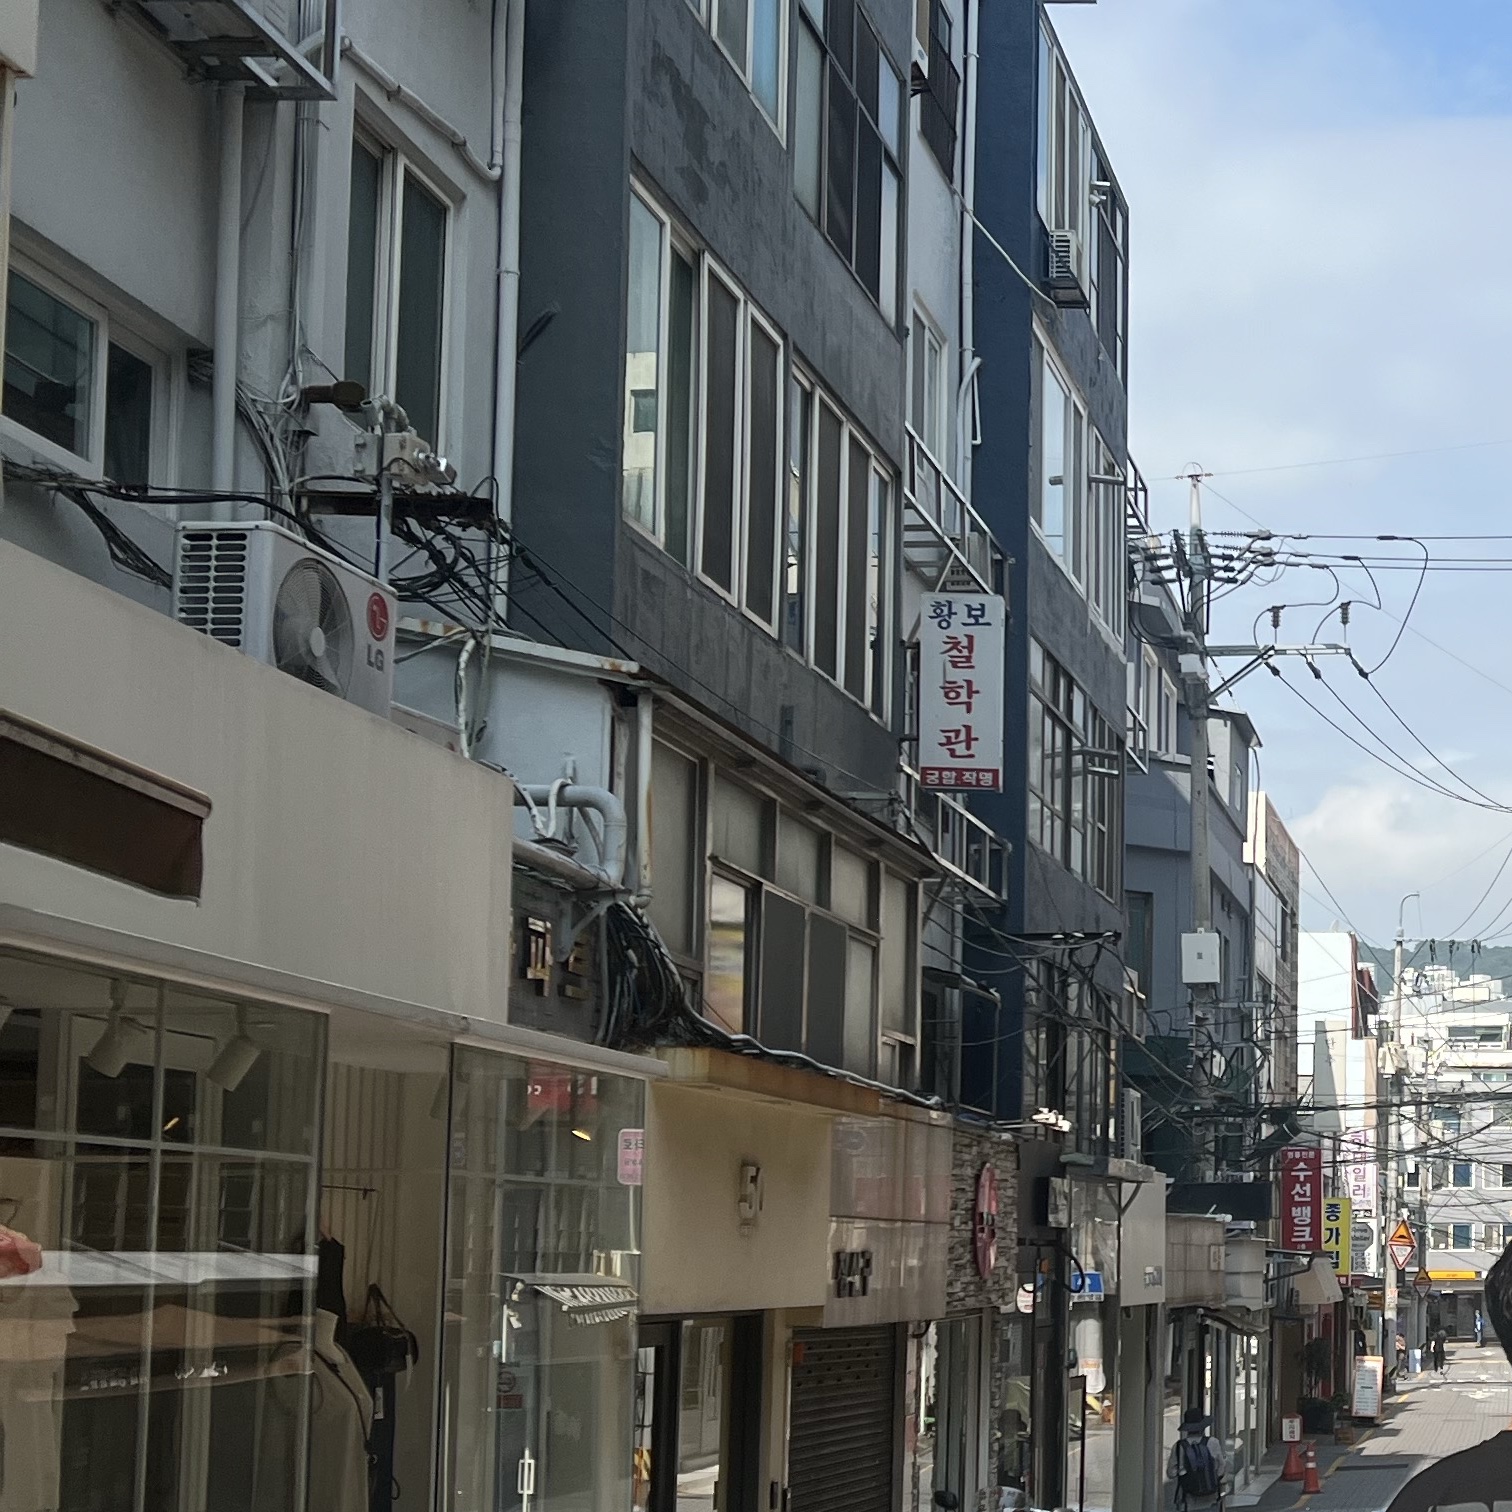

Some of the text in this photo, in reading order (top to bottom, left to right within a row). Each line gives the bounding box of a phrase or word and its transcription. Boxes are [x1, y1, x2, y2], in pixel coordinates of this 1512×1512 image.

[928, 599, 992, 630] 황보
[366, 643, 385, 671] LG
[937, 633, 981, 760] 철학관
[1290, 1161, 1313, 1242] 수선뱅크
